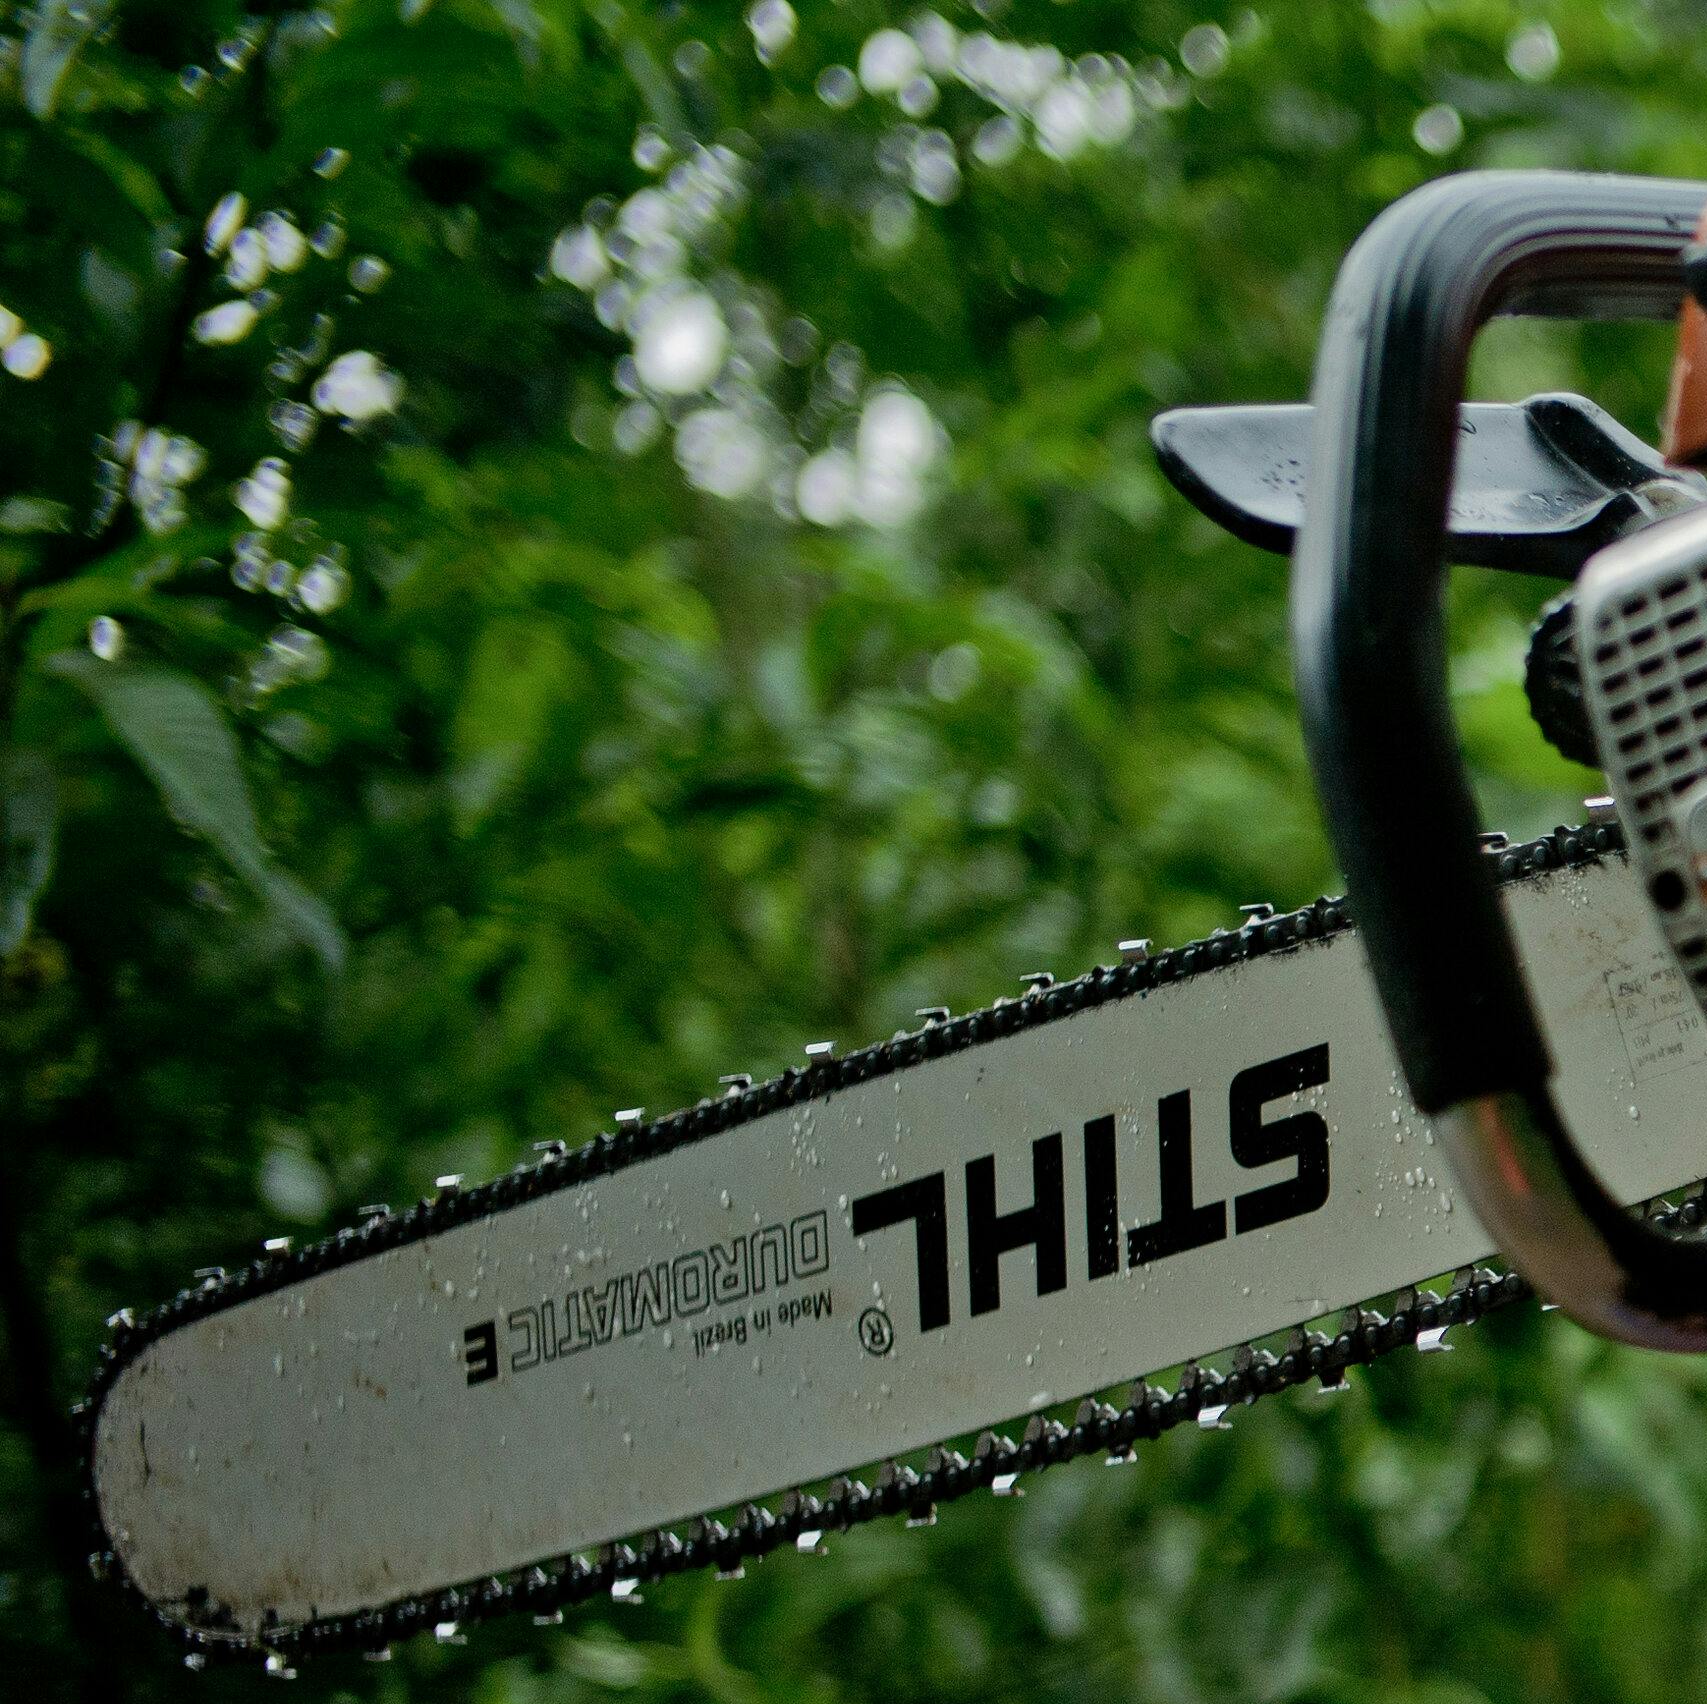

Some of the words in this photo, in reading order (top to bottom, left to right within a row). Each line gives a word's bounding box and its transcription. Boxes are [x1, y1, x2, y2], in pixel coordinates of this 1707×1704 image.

[852, 1042, 1331, 1333] STIHL
[508, 1209, 830, 1373] DUROMATIC
[753, 1307, 772, 1338] in
[778, 1288, 833, 1329] Made
[463, 1319, 499, 1388] E
